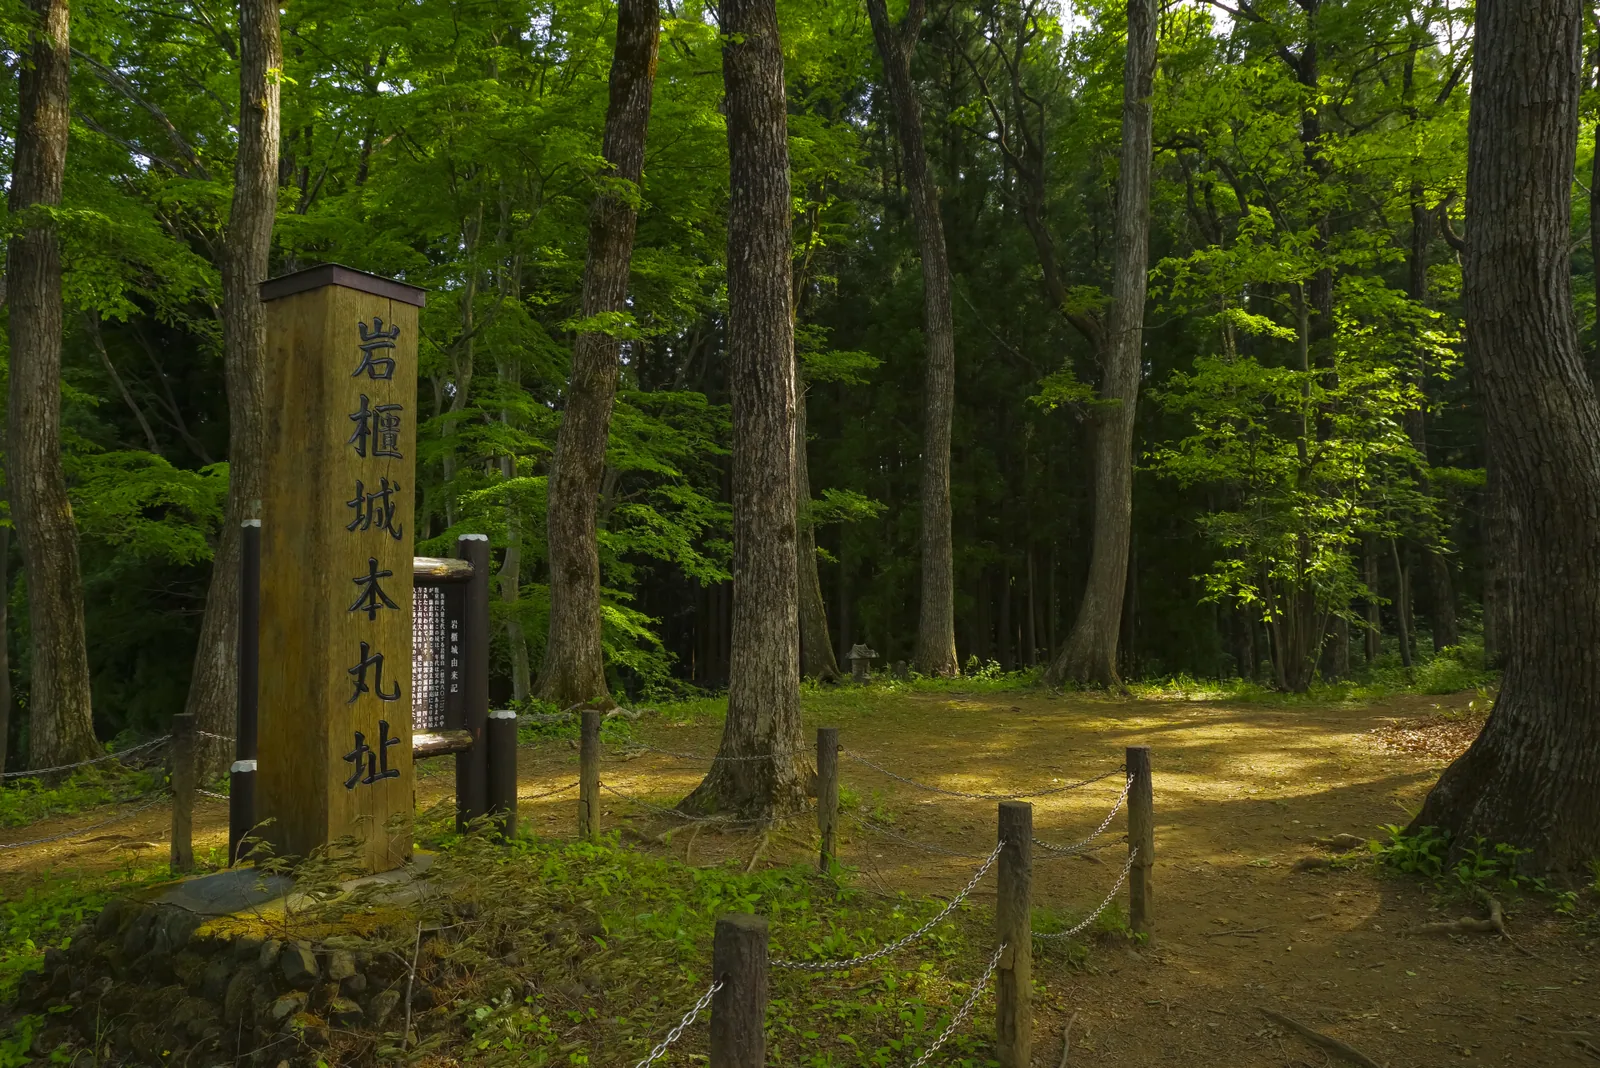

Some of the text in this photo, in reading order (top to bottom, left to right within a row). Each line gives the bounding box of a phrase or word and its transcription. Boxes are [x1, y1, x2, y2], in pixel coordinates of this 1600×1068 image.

[343, 316, 403, 790] 岩櫃城本丸址
